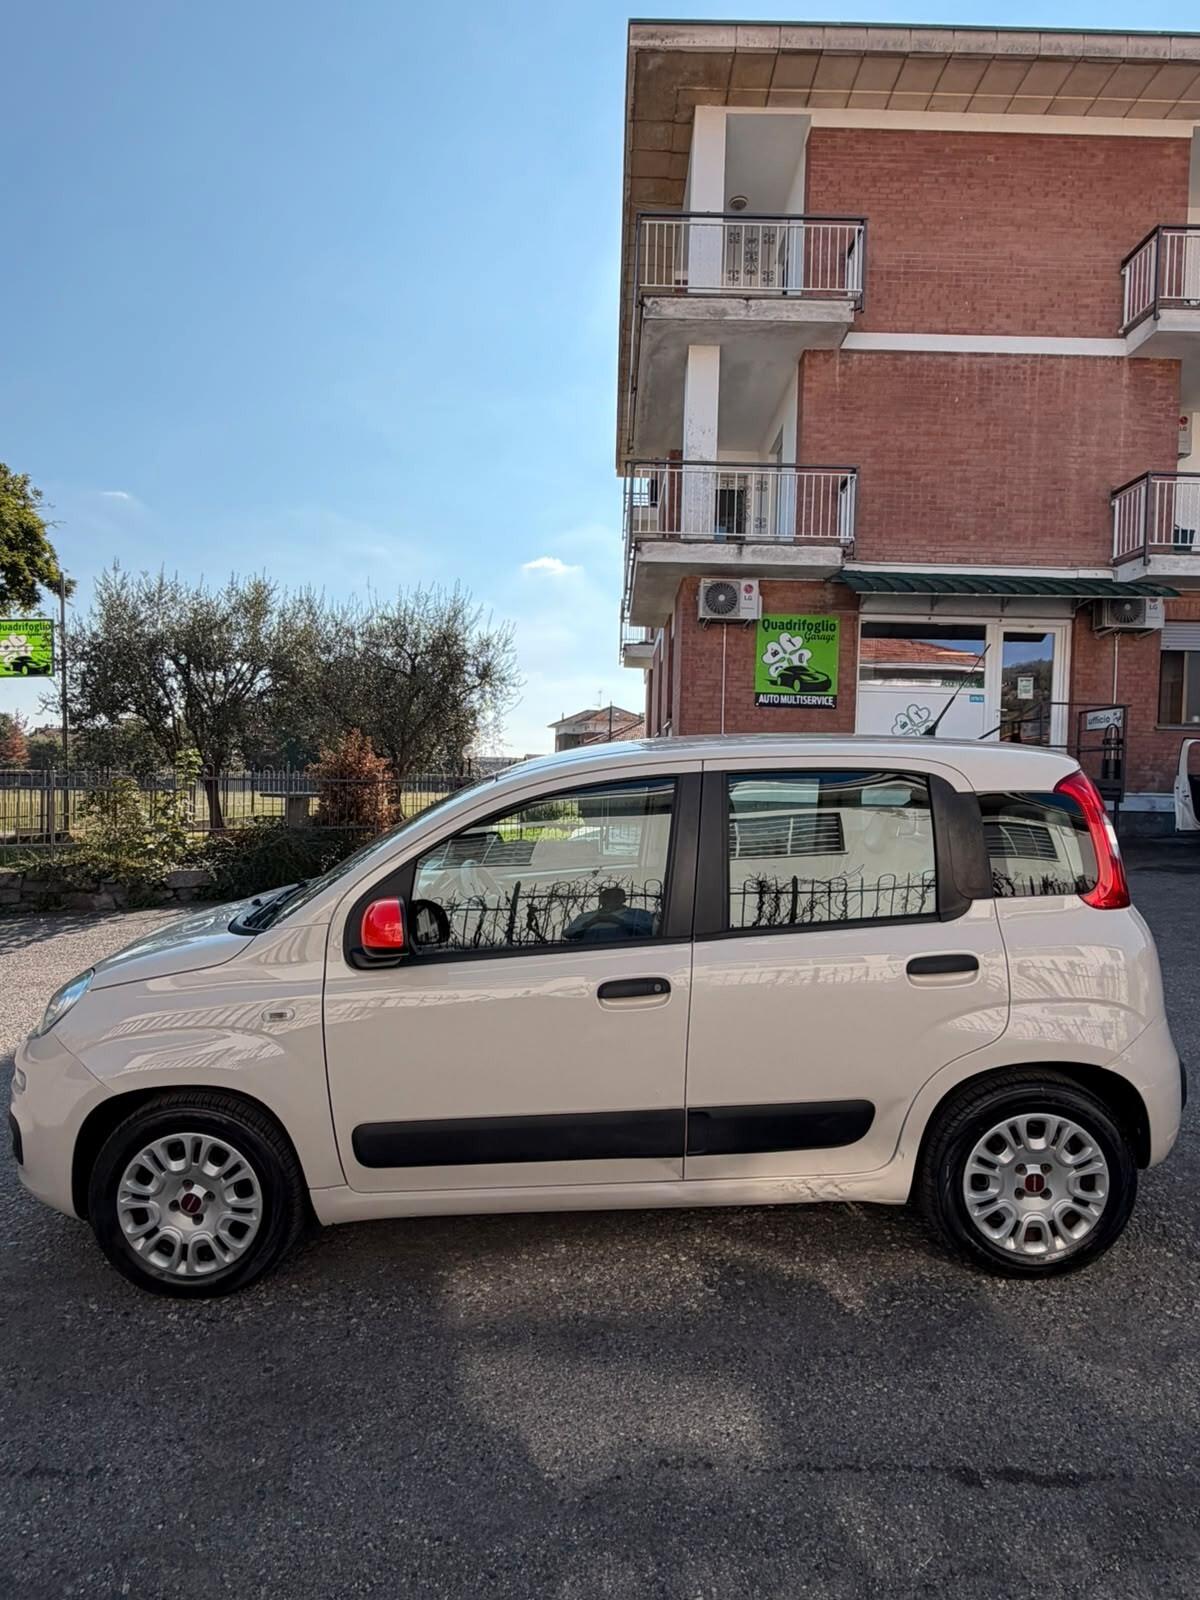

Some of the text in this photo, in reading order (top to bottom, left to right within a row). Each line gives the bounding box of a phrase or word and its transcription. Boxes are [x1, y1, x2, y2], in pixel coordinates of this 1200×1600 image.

[0, 622, 51, 632] uadrifoglio
[762, 619, 836, 633] Quadrifoglio
[804, 632, 835, 643] Garage
[759, 694, 834, 706] AUTO MULTISERVICE
